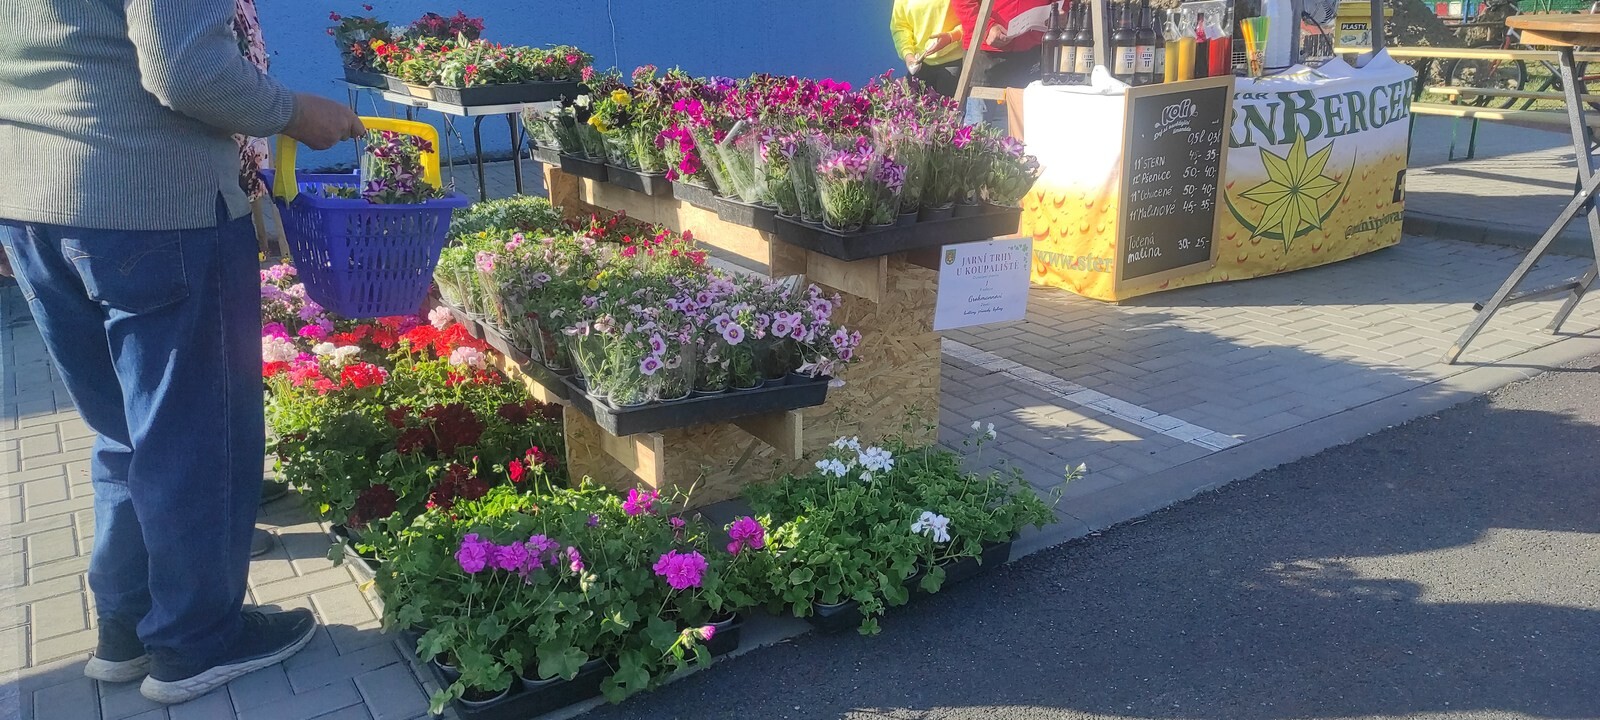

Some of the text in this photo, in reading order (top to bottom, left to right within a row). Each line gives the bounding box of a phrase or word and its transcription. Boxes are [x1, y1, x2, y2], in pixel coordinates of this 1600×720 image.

[961, 252, 1013, 267] JARNÍ TRHY
[956, 267, 962, 277] U
